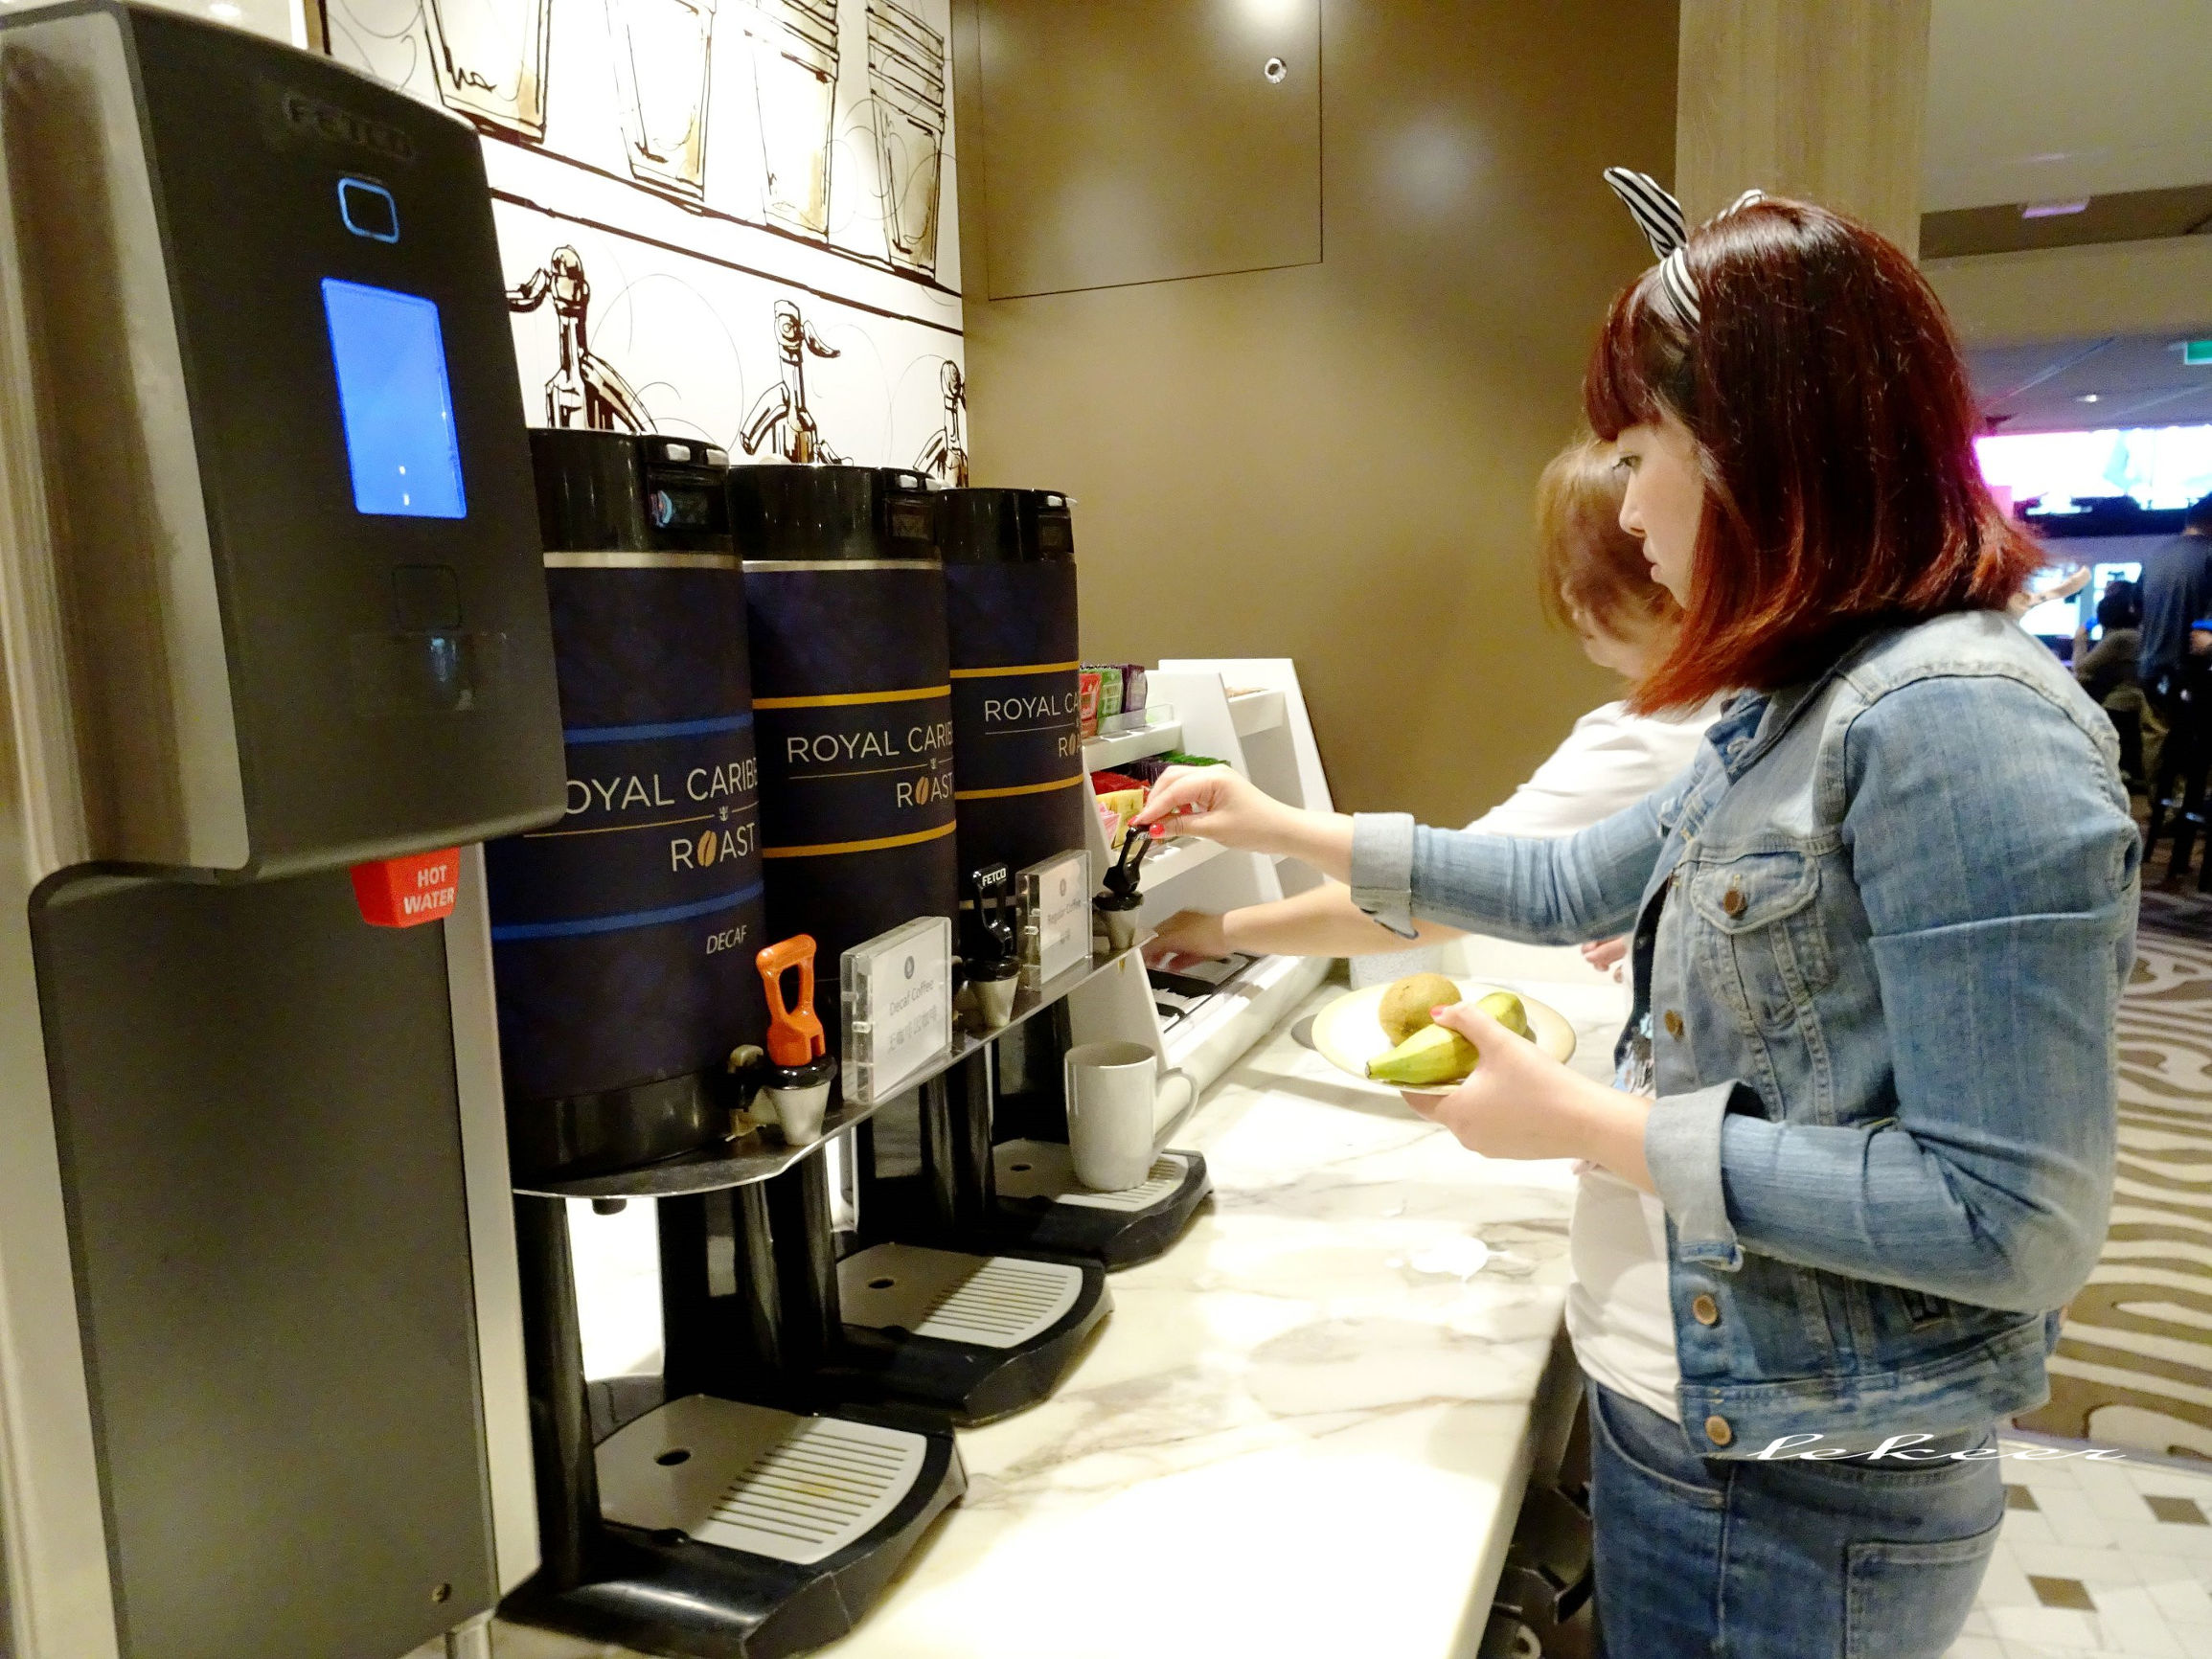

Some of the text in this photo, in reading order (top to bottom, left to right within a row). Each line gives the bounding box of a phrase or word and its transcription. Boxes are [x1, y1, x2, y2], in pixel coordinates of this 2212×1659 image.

[984, 695, 1061, 722] ROYAL
[787, 730, 901, 763] ROYAL
[566, 773, 675, 815] OYAL
[418, 865, 447, 888] HOT
[982, 868, 1007, 887] FETCO
[403, 887, 454, 915] WATER
[705, 924, 747, 955] DECAF
[889, 980, 934, 1016] Decaf Coffee
